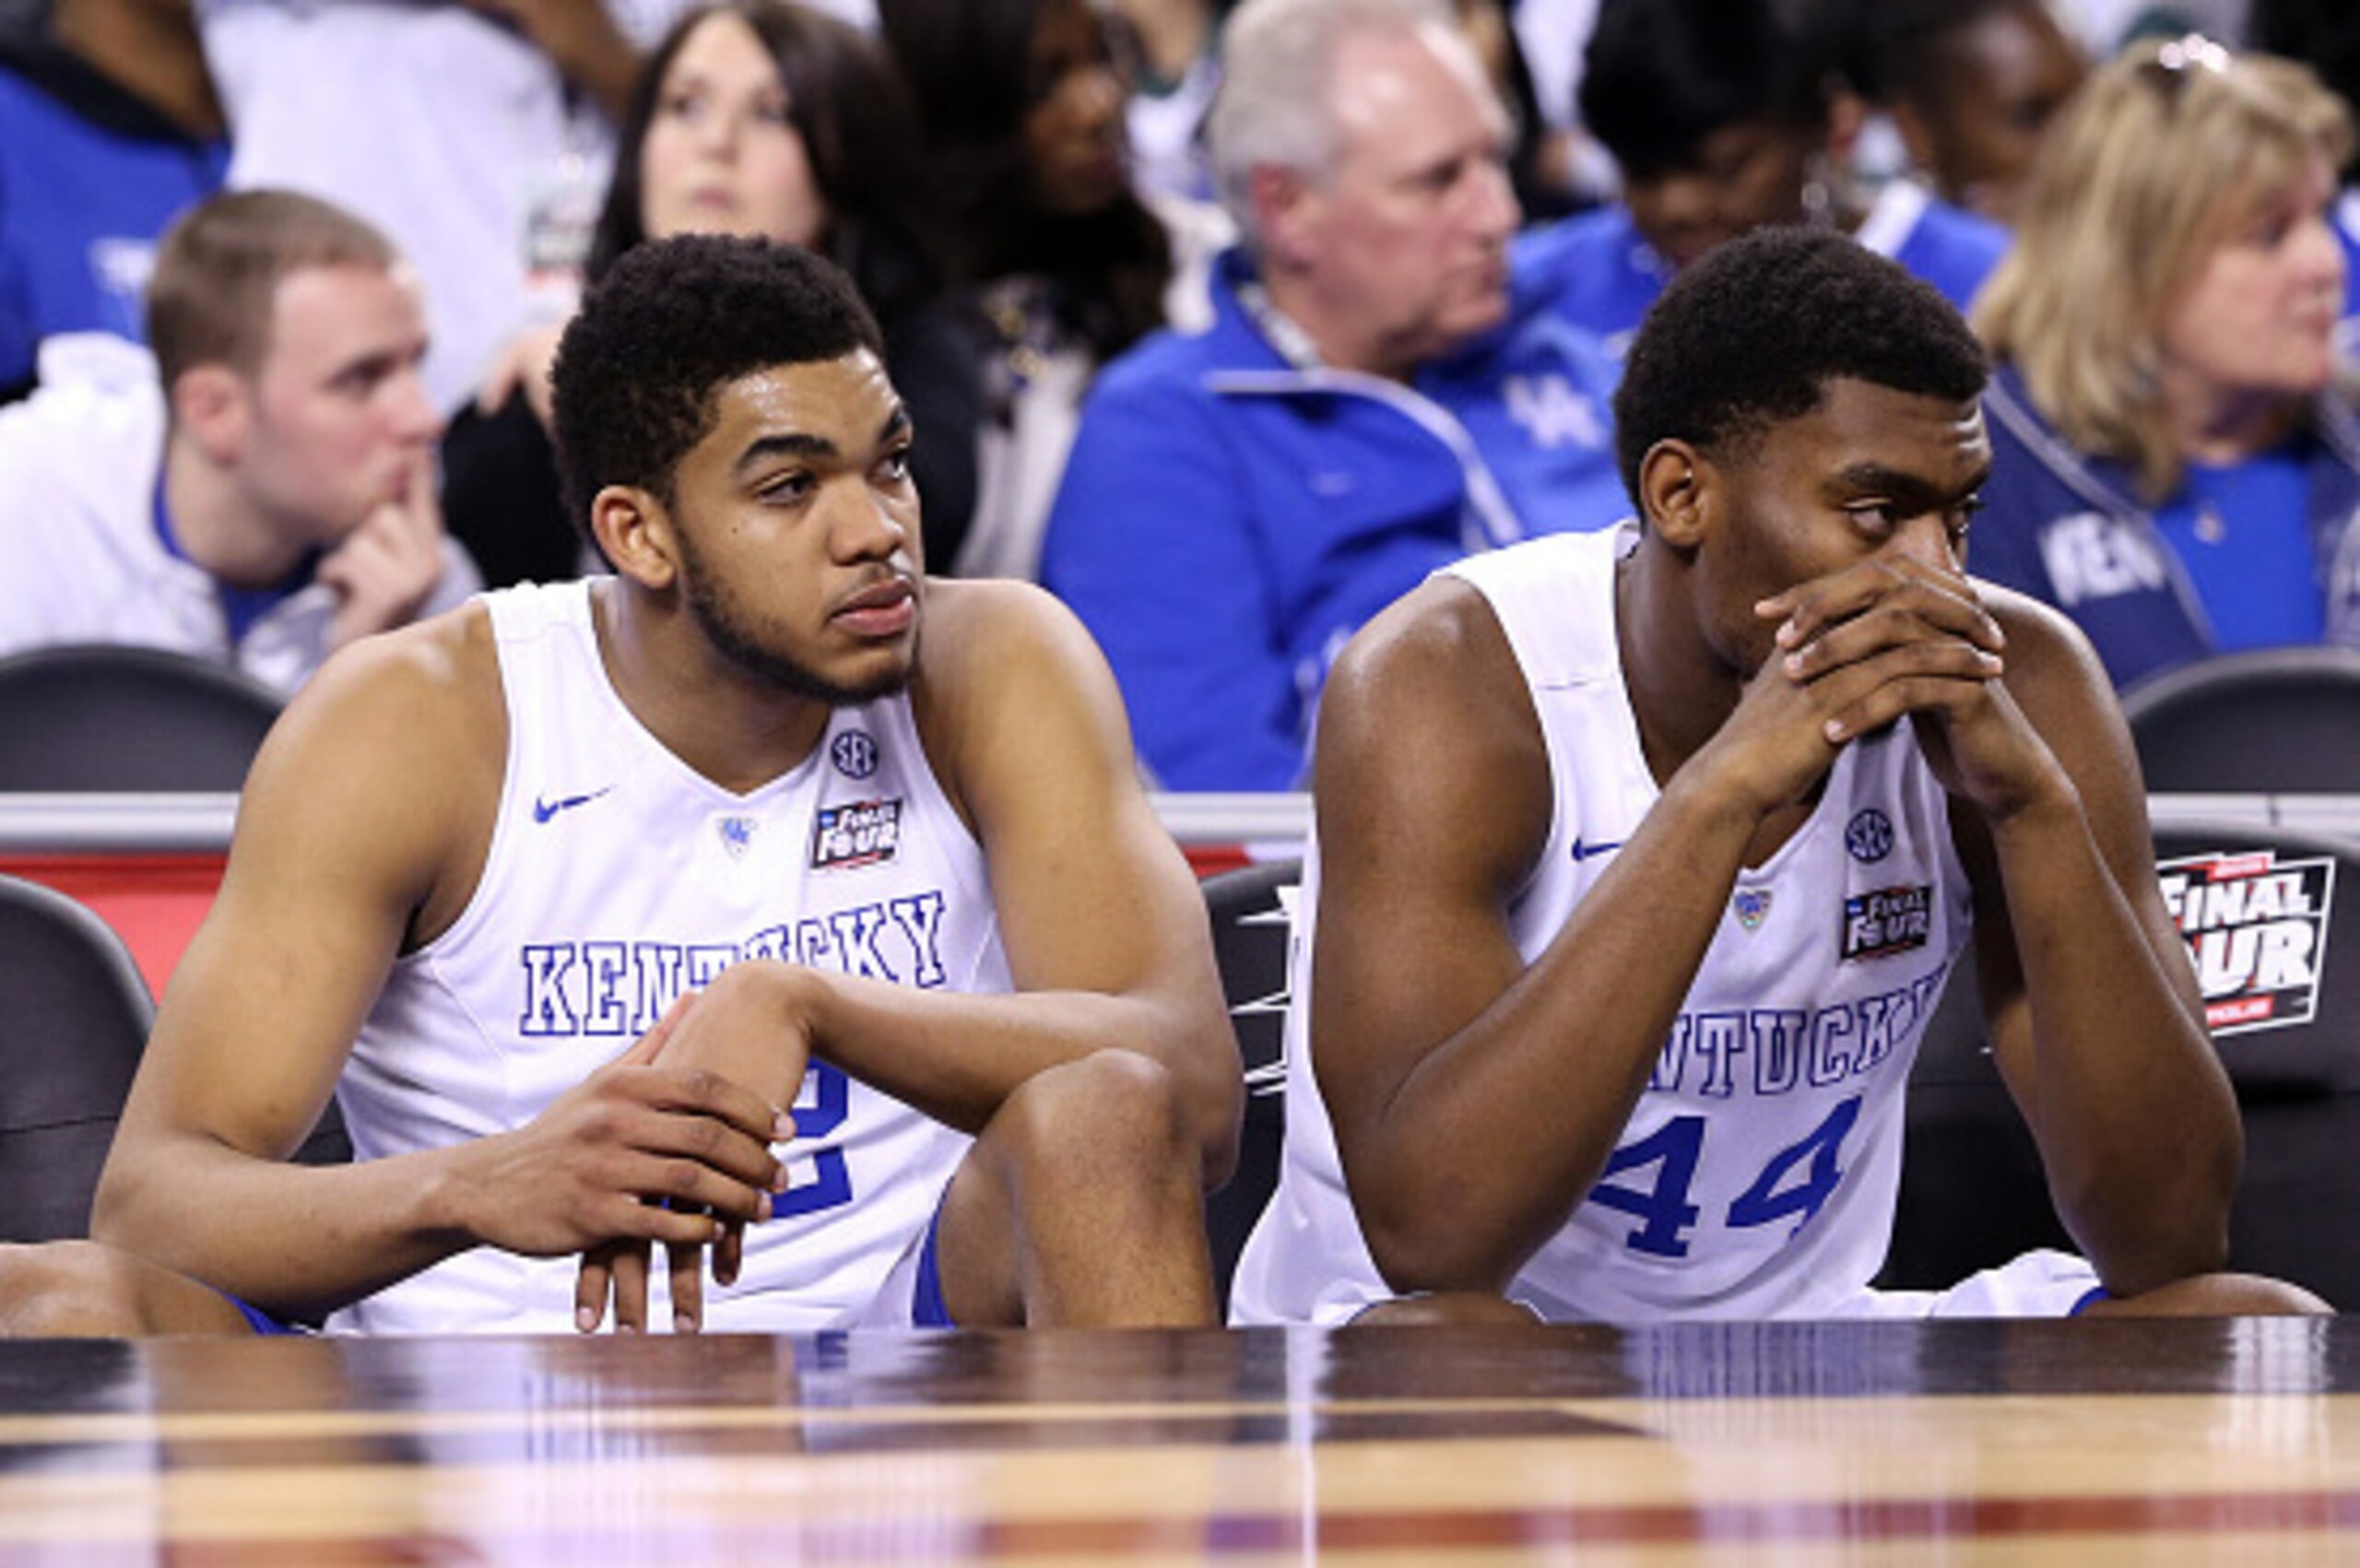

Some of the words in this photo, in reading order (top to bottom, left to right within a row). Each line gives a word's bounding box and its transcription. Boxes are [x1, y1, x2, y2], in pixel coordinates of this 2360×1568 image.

[2158, 873, 2311, 930] FINAL
[2183, 920, 2314, 997] UR
[1639, 963, 1948, 1098] NTUCKY
[1589, 1095, 1862, 1256] 44
